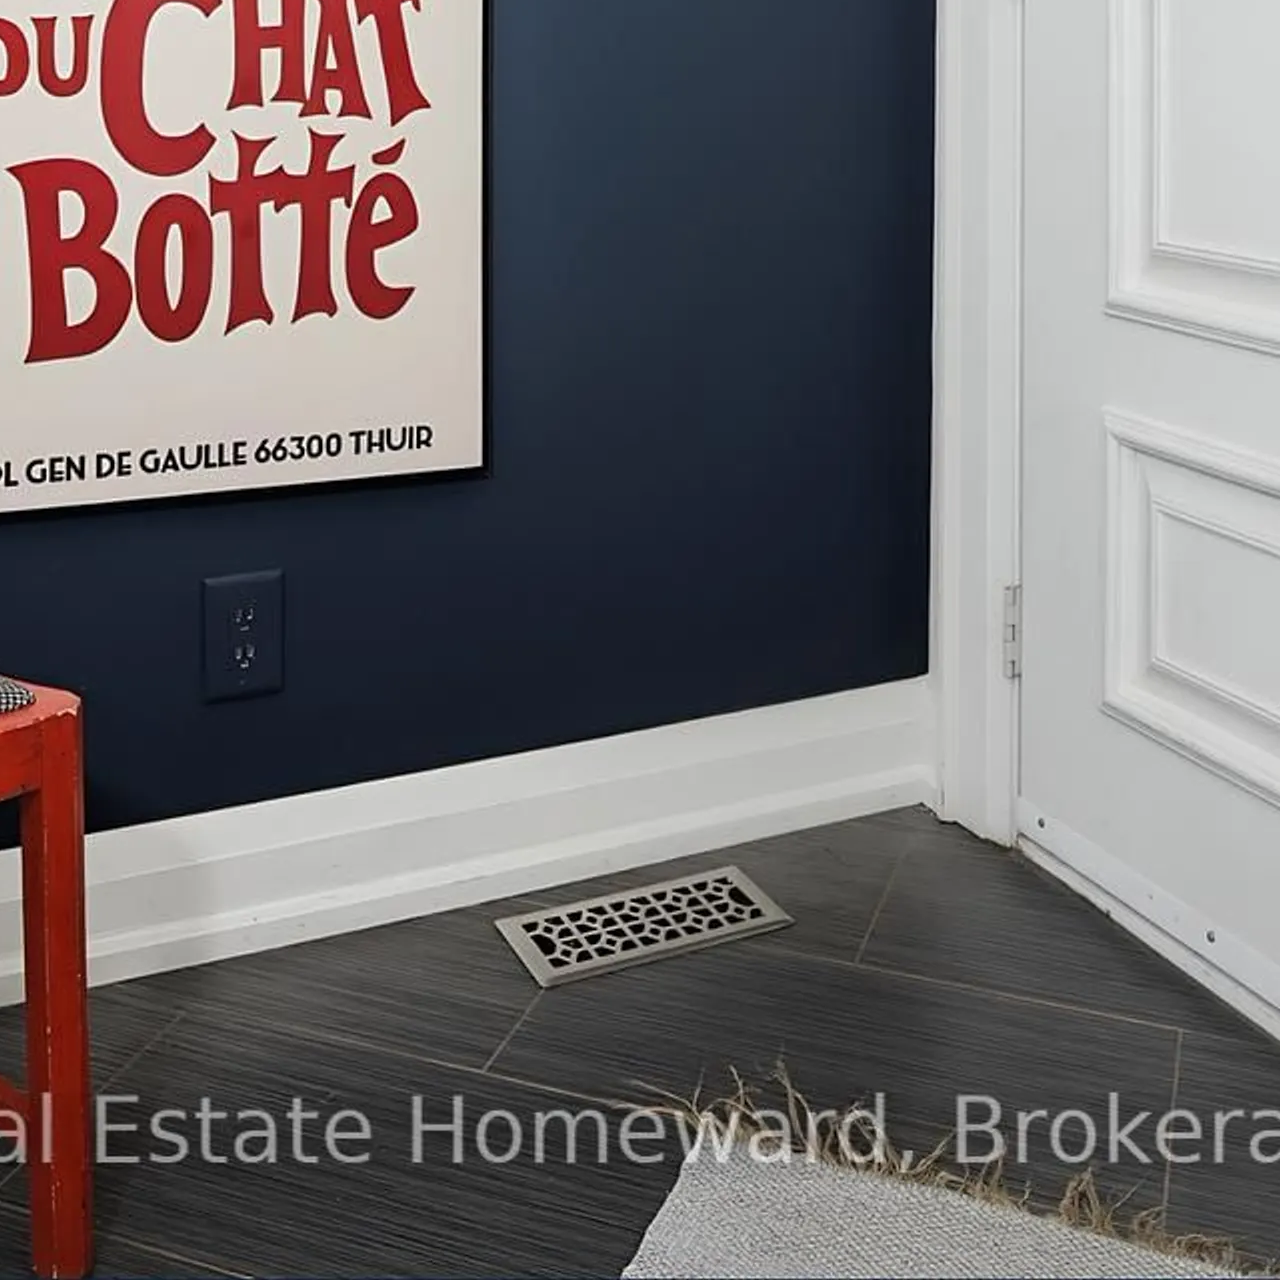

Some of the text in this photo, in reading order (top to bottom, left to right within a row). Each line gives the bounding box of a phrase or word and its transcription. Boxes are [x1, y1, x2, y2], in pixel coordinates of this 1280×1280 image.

[6, 127, 420, 365] Botté
[25, 455, 86, 485] GEN
[95, 450, 132, 479] DE
[139, 441, 248, 474] GAULLE
[254, 432, 342, 464] 66300
[348, 425, 433, 455] THUIR
